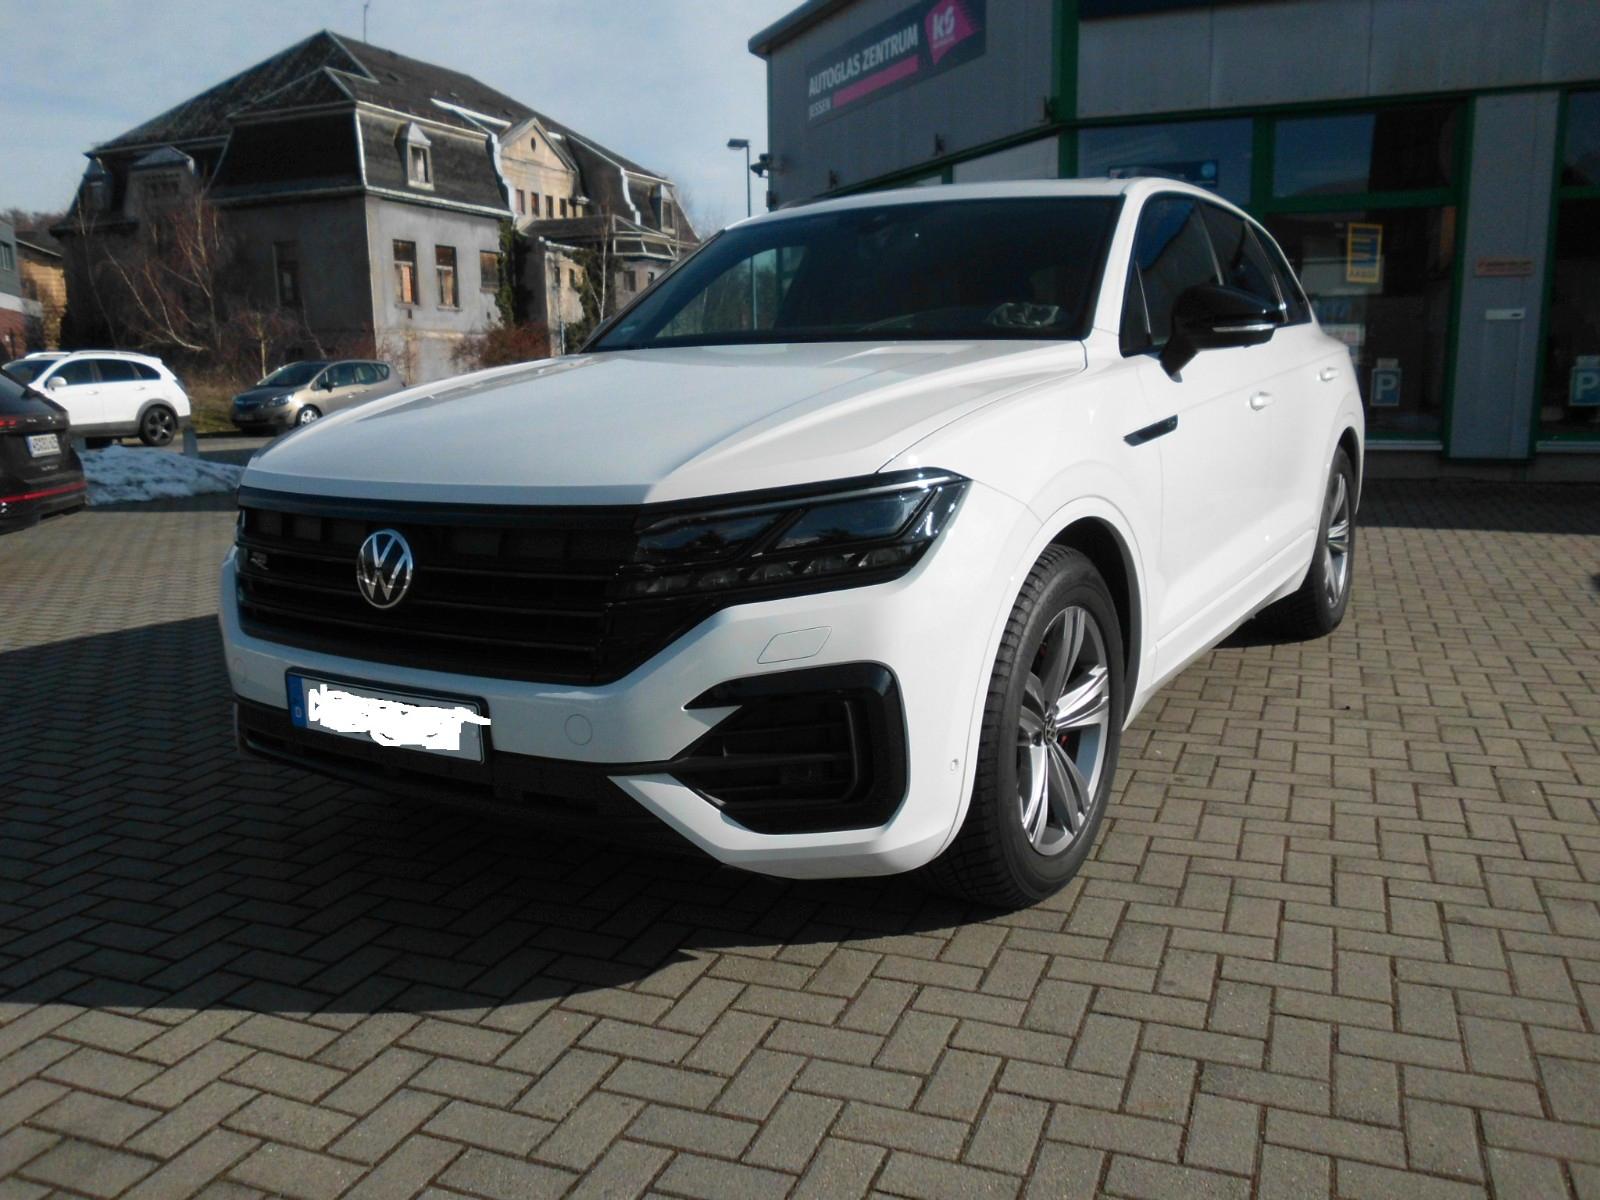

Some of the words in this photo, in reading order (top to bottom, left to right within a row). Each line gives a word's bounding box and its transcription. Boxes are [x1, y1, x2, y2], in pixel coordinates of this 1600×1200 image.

[808, 52, 861, 98] AUTOGLAS
[862, 23, 919, 71] ZENTRUM
[1376, 374, 1397, 400] P
[1575, 372, 1599, 400] P
